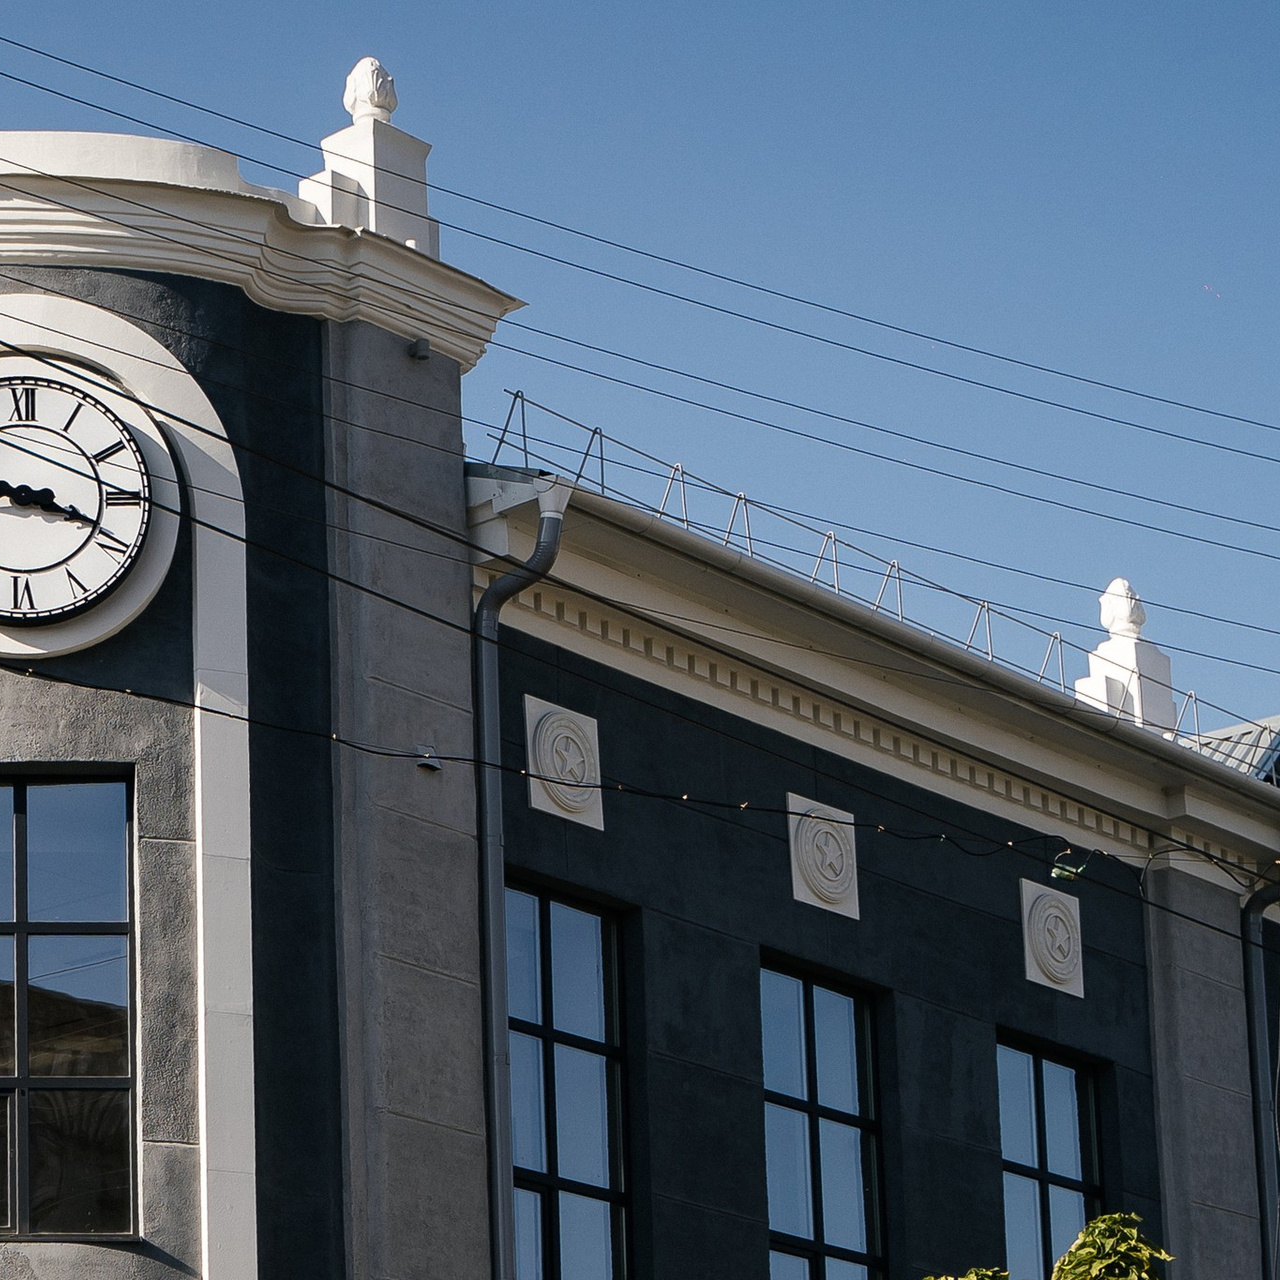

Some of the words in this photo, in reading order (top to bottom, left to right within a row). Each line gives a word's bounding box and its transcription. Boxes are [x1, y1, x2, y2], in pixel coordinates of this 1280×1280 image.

[8, 388, 38, 421] XII
[61, 401, 85, 433] I
[90, 438, 128, 466] II
[105, 489, 141, 509] III
[94, 527, 131, 564] IV
[10, 575, 37, 610] VI
[64, 566, 91, 599] V
